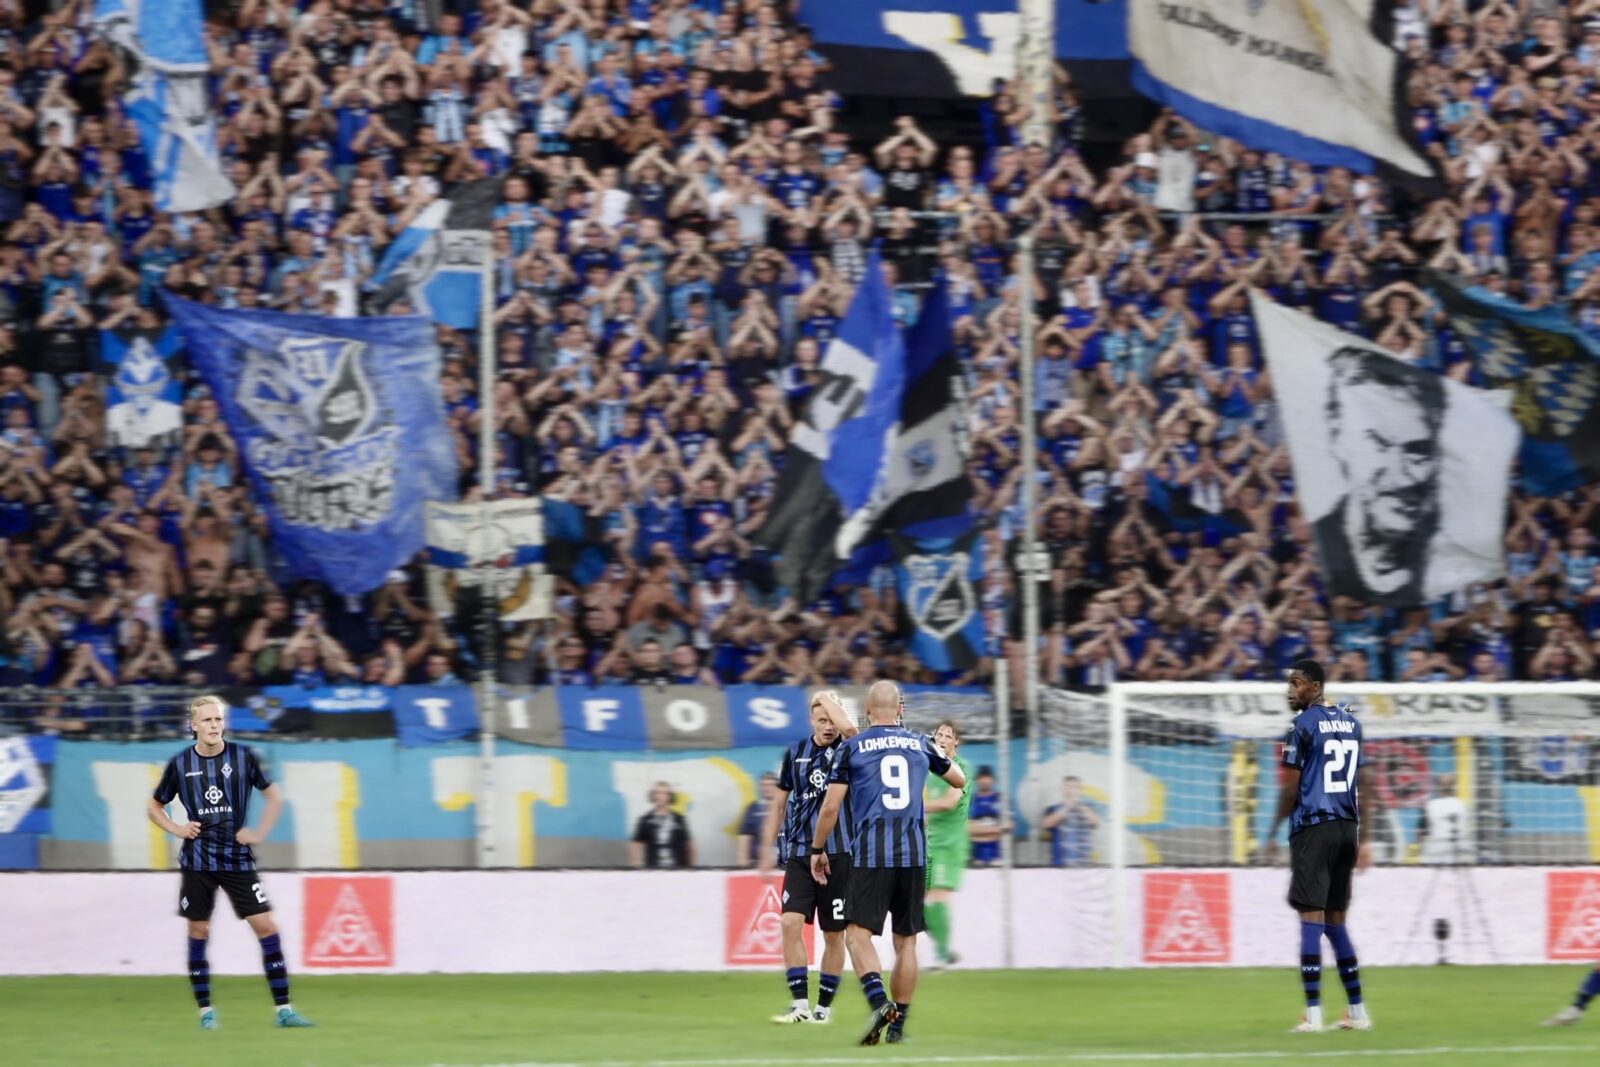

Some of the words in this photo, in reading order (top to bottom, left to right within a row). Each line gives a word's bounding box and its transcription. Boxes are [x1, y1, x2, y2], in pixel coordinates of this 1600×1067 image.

[858, 736, 922, 753] LOHKEMPER
[880, 754, 911, 811] 9
[1323, 739, 1359, 793] 27
[197, 806, 233, 815] GALERIA
